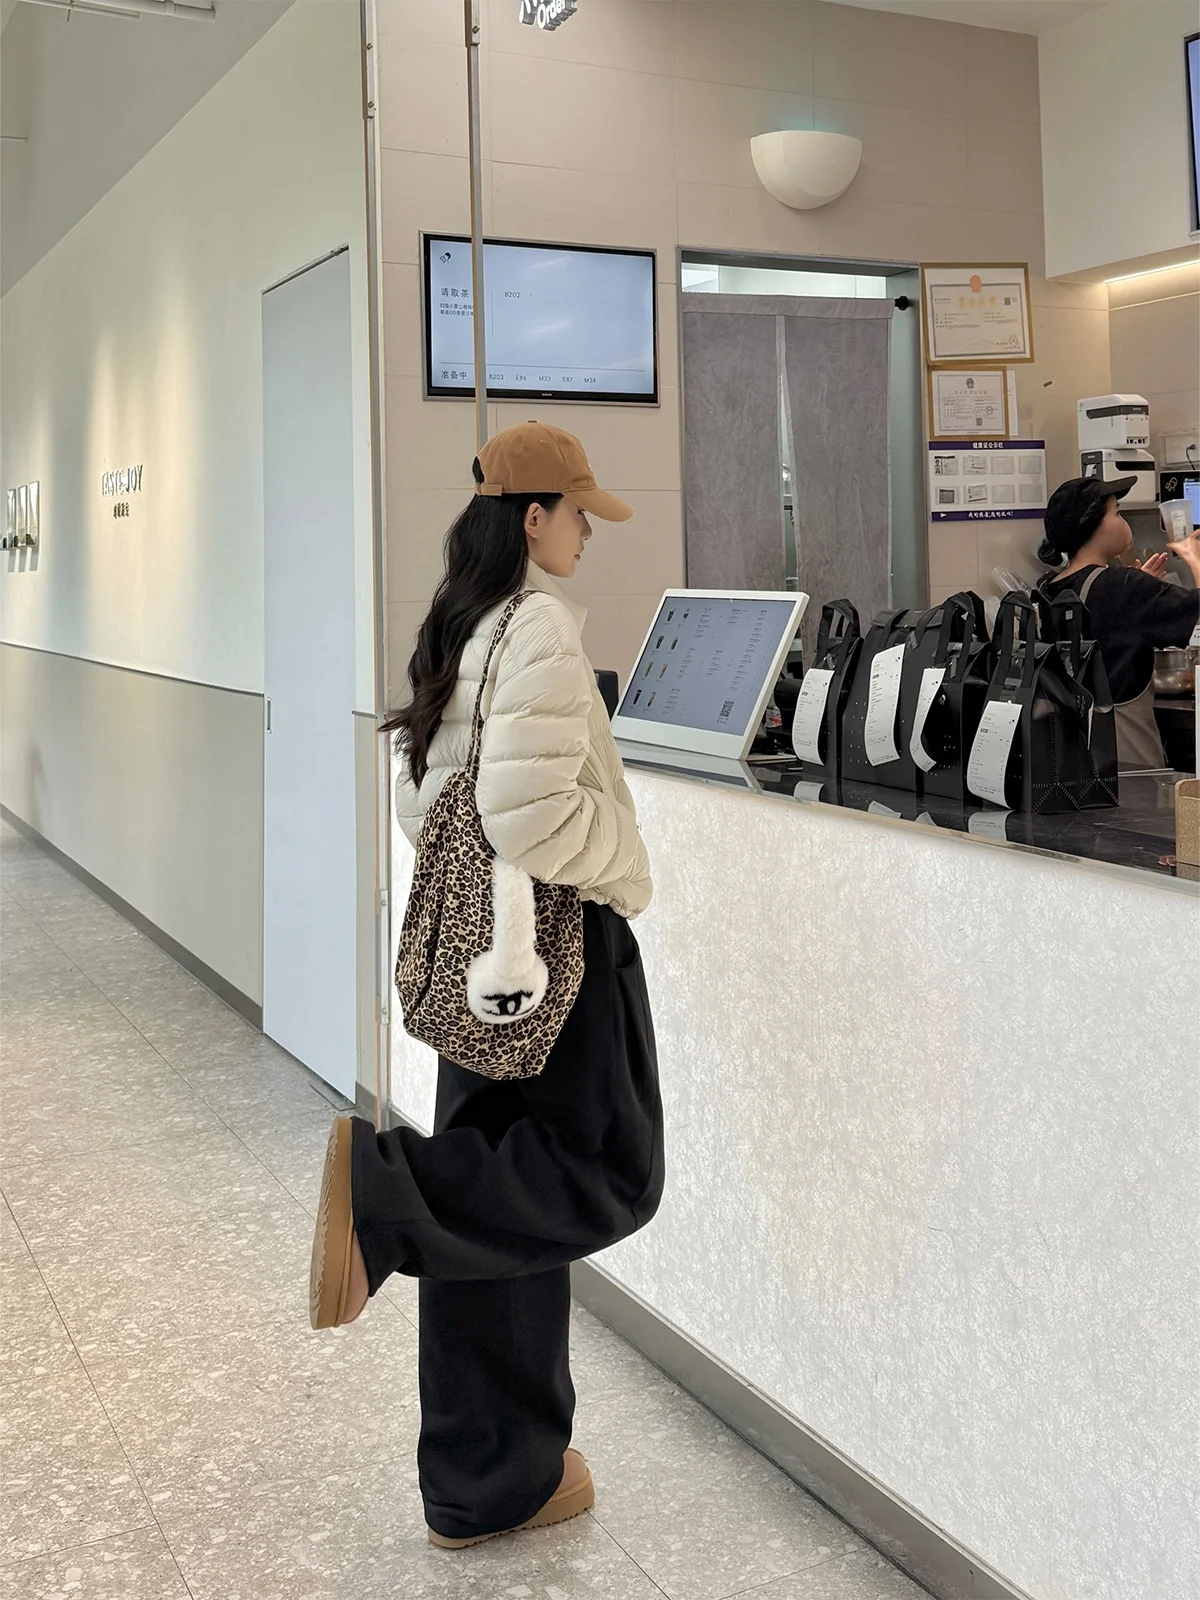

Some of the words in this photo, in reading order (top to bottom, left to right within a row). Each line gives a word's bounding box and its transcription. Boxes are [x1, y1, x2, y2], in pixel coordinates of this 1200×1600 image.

[441, 287, 469, 298] 请取茶
[441, 370, 467, 380] 准备中
[126, 464, 143, 494] JOY
